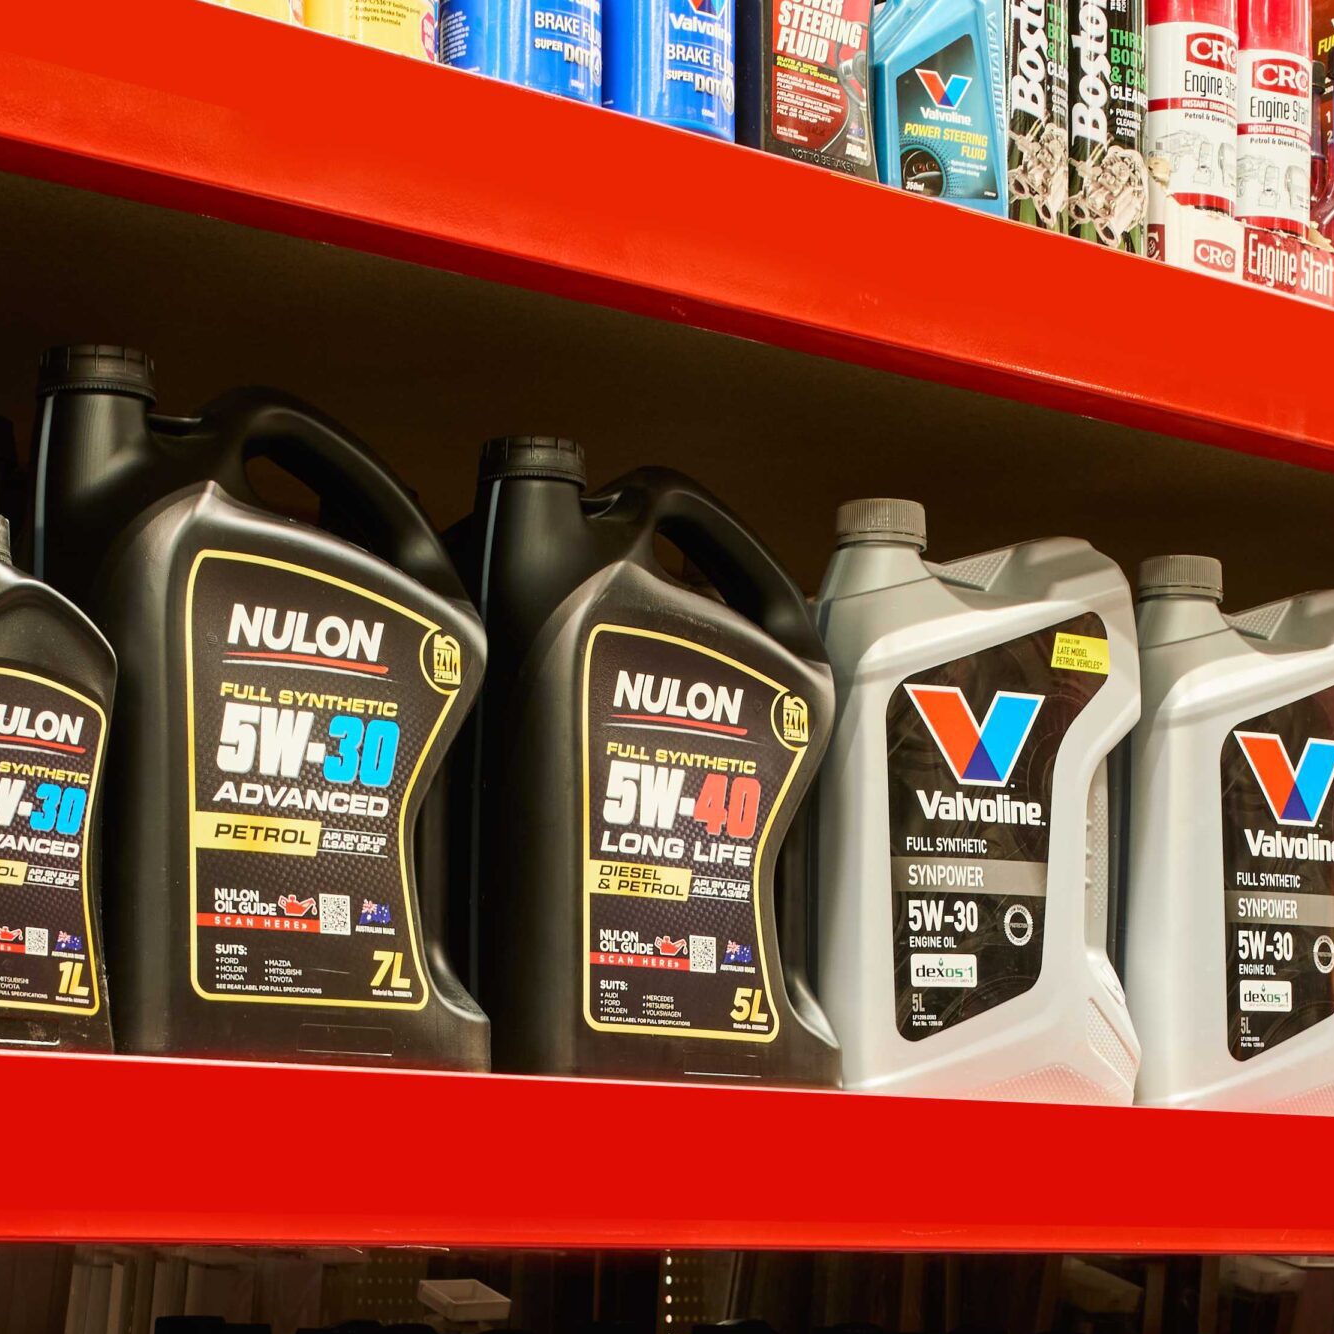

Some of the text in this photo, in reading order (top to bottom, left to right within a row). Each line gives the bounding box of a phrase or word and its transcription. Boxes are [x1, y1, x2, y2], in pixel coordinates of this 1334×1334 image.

[778, 1, 863, 49] STEERING
[667, 43, 711, 65] BRAKE
[777, 27, 830, 63] FLUID
[666, 69, 722, 95] SUPER DOT
[1256, 64, 1309, 93] CRC
[921, 107, 972, 125] Valvoline
[1250, 96, 1289, 126] Engine
[904, 122, 988, 148] POWER STEERING
[961, 146, 987, 161] FLUID
[1248, 234, 1334, 298] Engine Start
[227, 603, 385, 663] NULON
[1057, 646, 1087, 657] LATE MODEL
[220, 682, 398, 717] FULL SYNTHETIC
[613, 670, 744, 725] NULON
[215, 702, 400, 788] 5W-30
[212, 780, 389, 818] ADVANCED
[602, 762, 761, 840] 5W-40
[916, 789, 1046, 827] Valvoline
[600, 831, 752, 867] LONG LIFE
[907, 864, 984, 888] SYNPOWER
[908, 899, 979, 933] 5W-30
[909, 935, 957, 949] ENGINE OIL
[371, 950, 411, 989] 7L
[729, 987, 768, 1024] 5L
